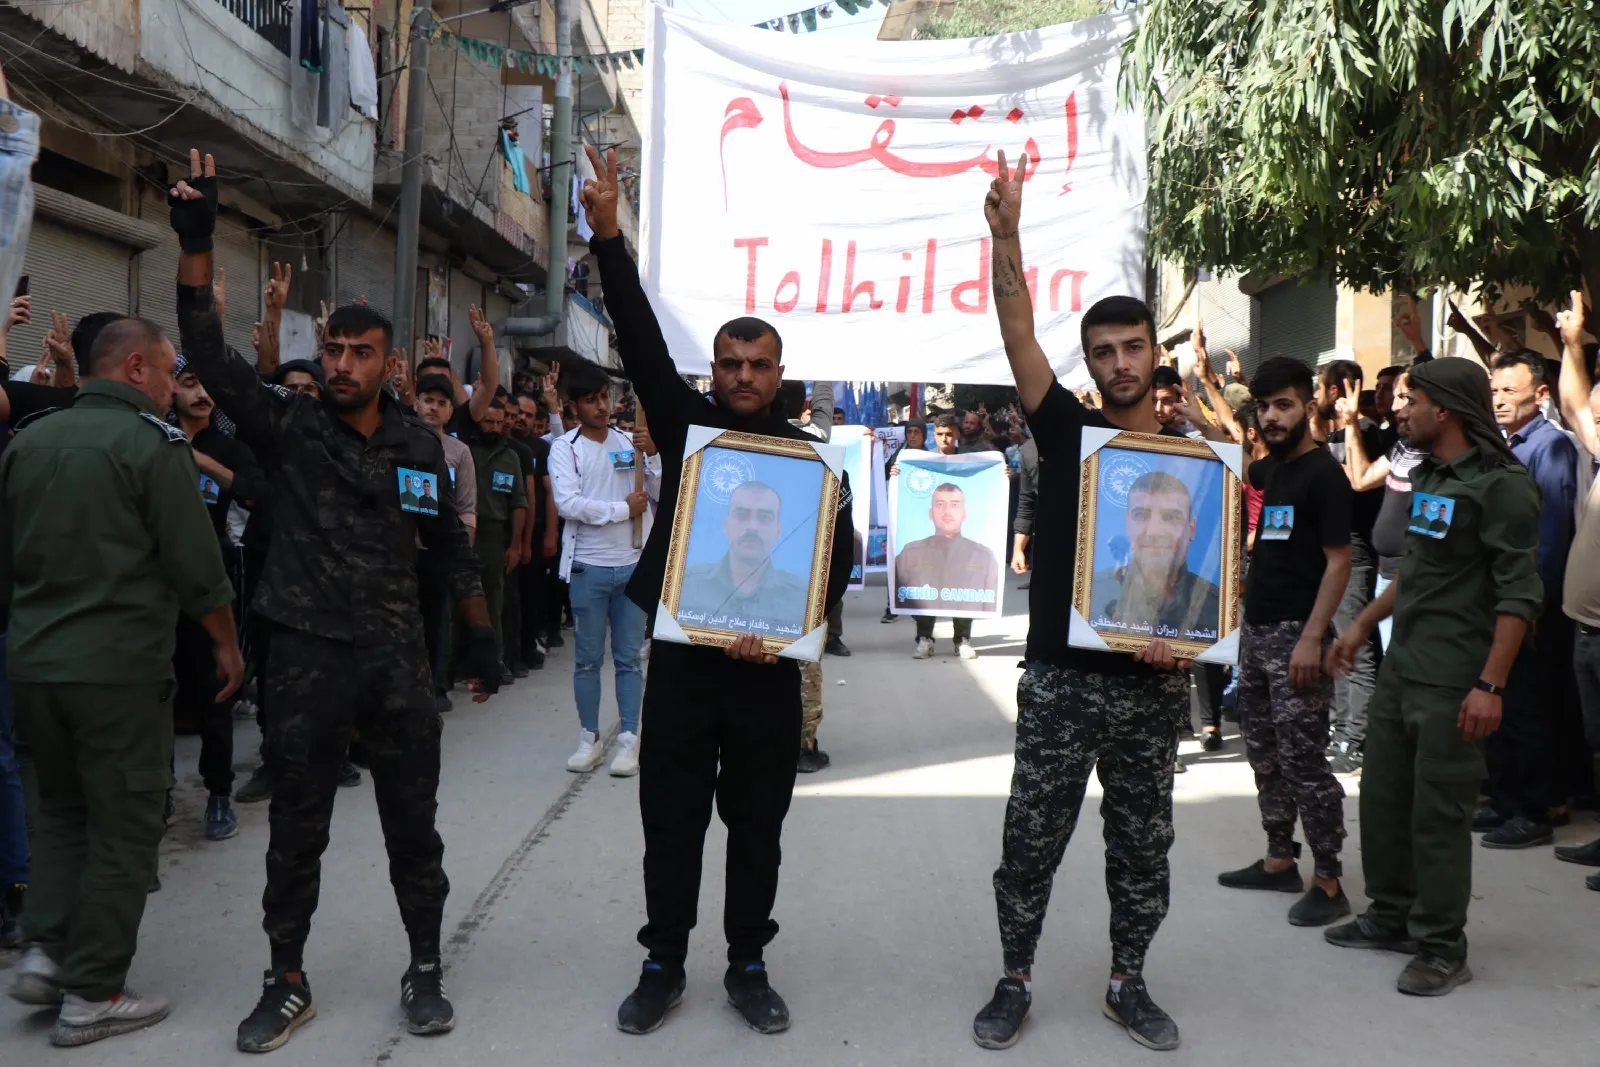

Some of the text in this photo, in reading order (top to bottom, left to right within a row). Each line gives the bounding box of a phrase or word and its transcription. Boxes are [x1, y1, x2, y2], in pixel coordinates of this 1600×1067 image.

[776, 623, 802, 634] الشهيد
[1131, 621, 1153, 634] رشيد
[1184, 626, 1216, 638] الشهيد
